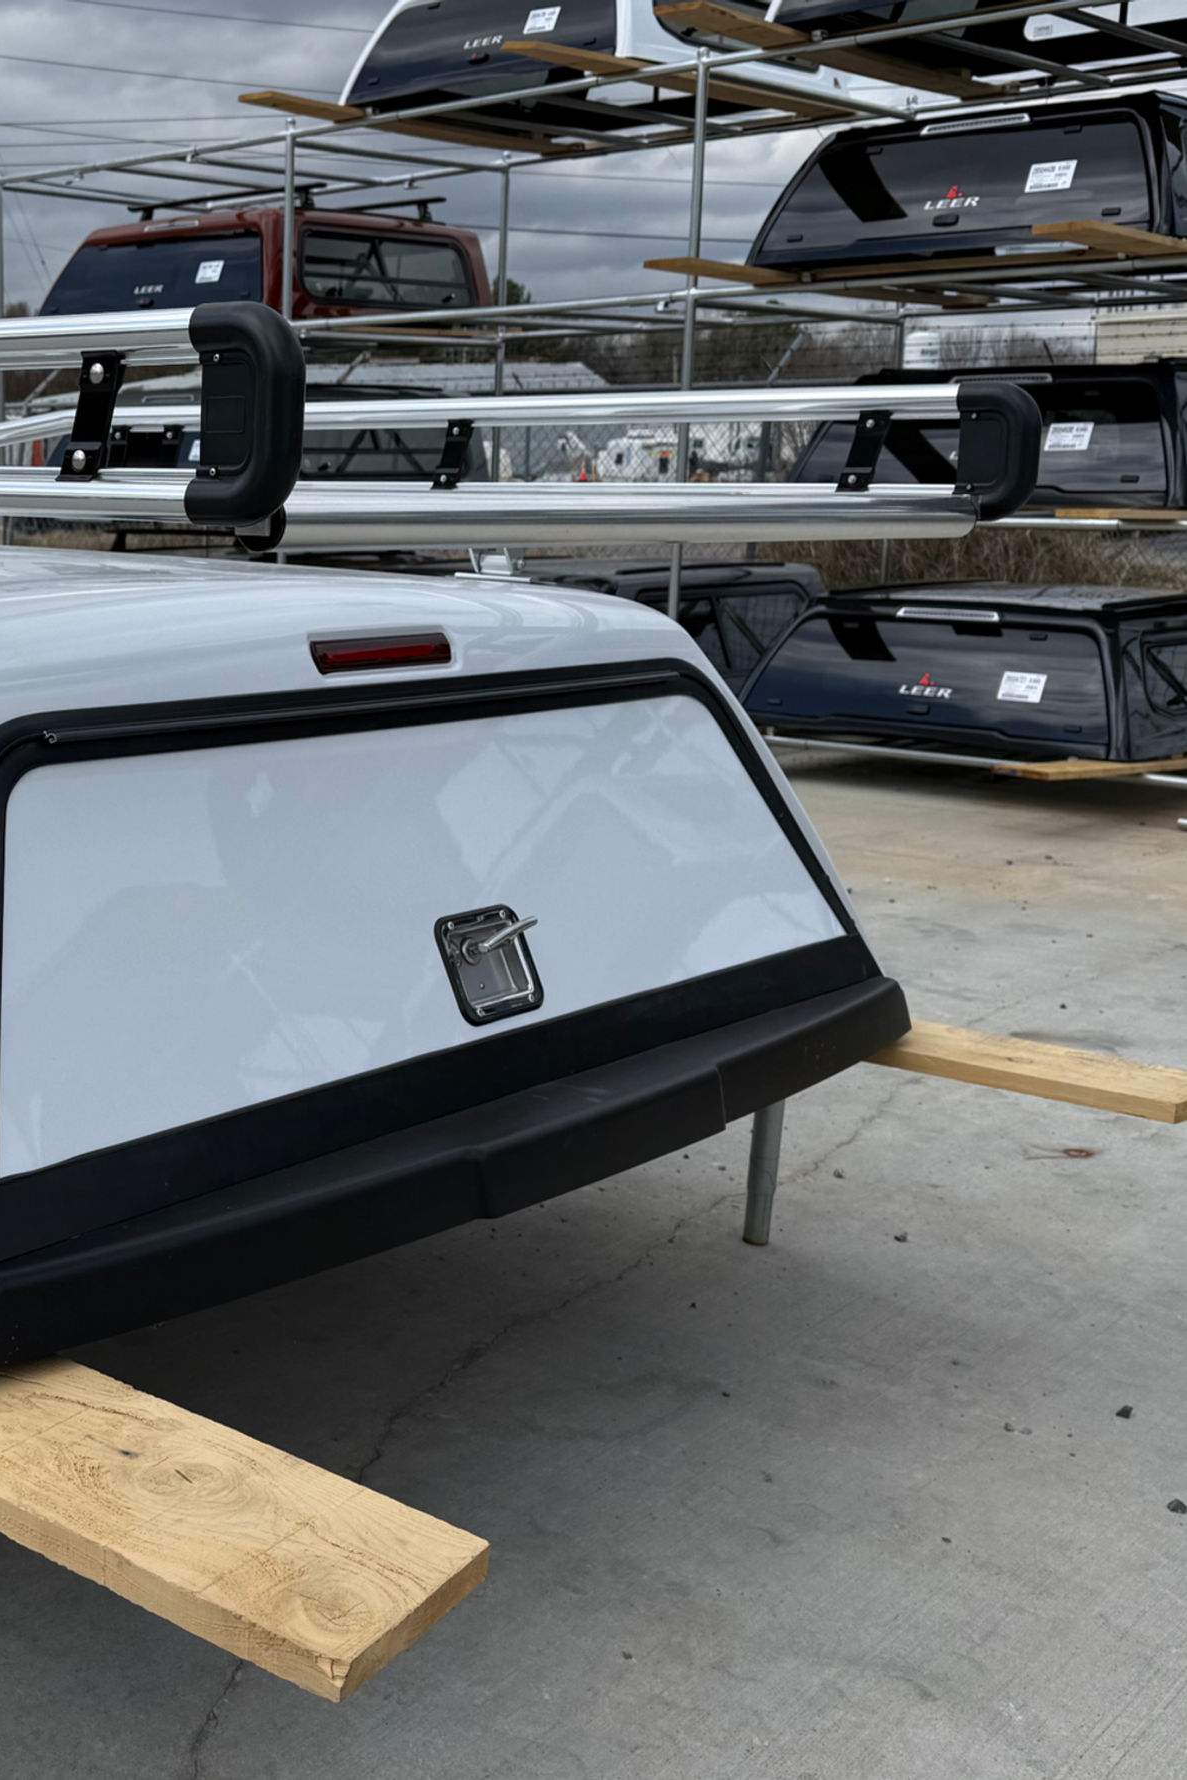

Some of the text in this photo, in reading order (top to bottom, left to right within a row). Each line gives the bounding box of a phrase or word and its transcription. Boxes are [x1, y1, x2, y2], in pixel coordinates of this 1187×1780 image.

[463, 35, 503, 49] LEER
[924, 196, 980, 210] LEER
[133, 284, 164, 295] LEER
[899, 684, 952, 699] LEER
